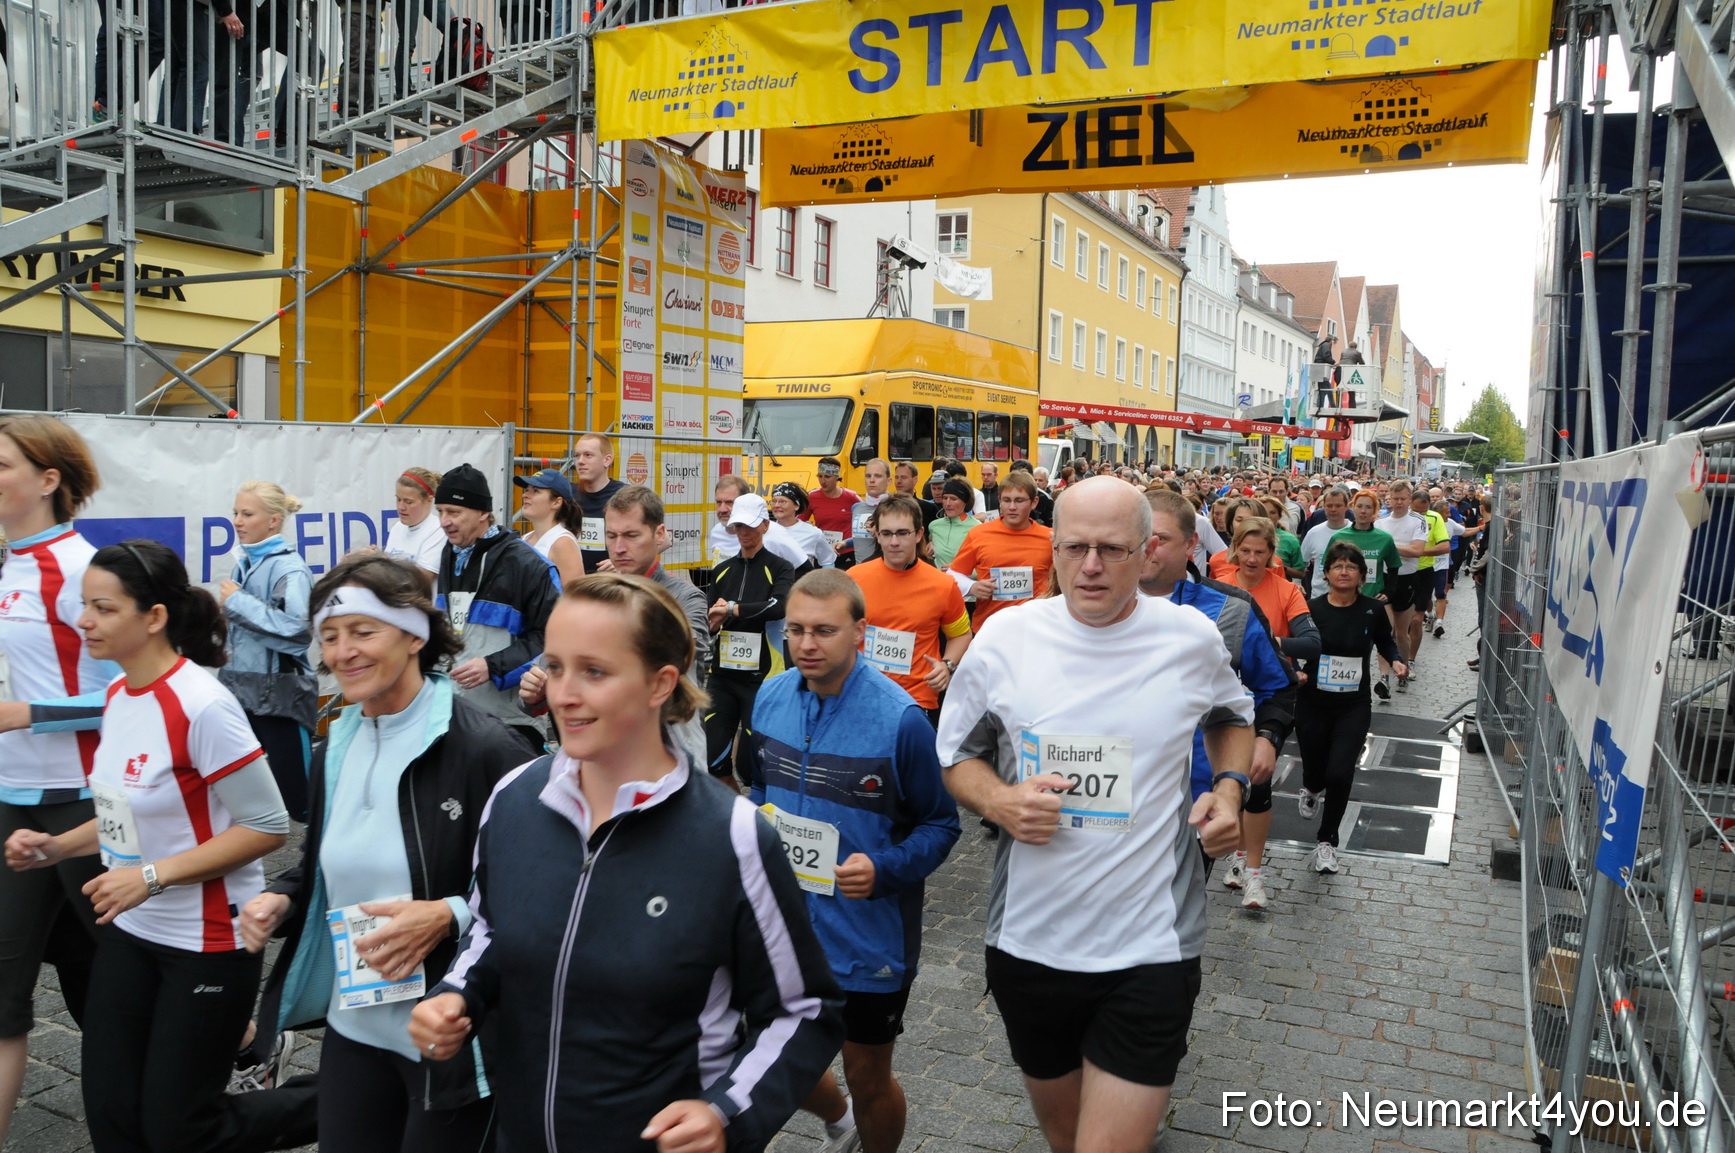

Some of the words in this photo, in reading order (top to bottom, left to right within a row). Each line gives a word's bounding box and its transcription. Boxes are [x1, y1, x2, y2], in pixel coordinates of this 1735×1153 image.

[1237, 12, 1368, 39] Neumarkter
[1374, 0, 1482, 25] Stadtlauf
[848, 0, 1174, 94] START
[628, 82, 718, 102] Neumarkter
[720, 72, 798, 92] Stadtlauf
[1298, 124, 1402, 142] Neumarkter
[1403, 113, 1489, 136] Stadtlauf
[1022, 103, 1195, 172] ZIEL
[790, 161, 869, 176] Neumarkter
[872, 155, 935, 171] Stadtlauf
[705, 184, 746, 206] MERZ
[632, 232, 649, 242] KANN
[717, 248, 741, 260] WITTMANN
[53, 250, 187, 302] WEBER
[623, 301, 654, 318] Sinupret
[711, 299, 745, 320] OBI
[623, 317, 642, 330] forte
[632, 340, 655, 351] Egner
[710, 354, 734, 370] MCM
[776, 383, 832, 393] TIMING
[912, 380, 943, 393] SPORTRONIC
[987, 392, 1001, 403] EVENT
[1000, 394, 1017, 405] SERVICE
[1051, 404, 1076, 412] Service
[626, 413, 654, 422] INTERSPORT
[710, 414, 730, 422] GERHART
[1150, 413, 1168, 421] 09181
[621, 421, 654, 431] HACKNER
[665, 463, 699, 479] Sinupret
[665, 480, 685, 494] forte
[673, 529, 700, 541] Egner
[1003, 579, 1028, 589] 2897
[877, 631, 899, 643] Roland
[731, 646, 753, 659] 299
[876, 644, 907, 660] 2896
[1331, 659, 1343, 667] Rita
[1331, 669, 1357, 680] 2447
[1047, 744, 1103, 762] Richard
[774, 815, 823, 841] Thorsten
[1084, 816, 1129, 827] PFLEIDERER
